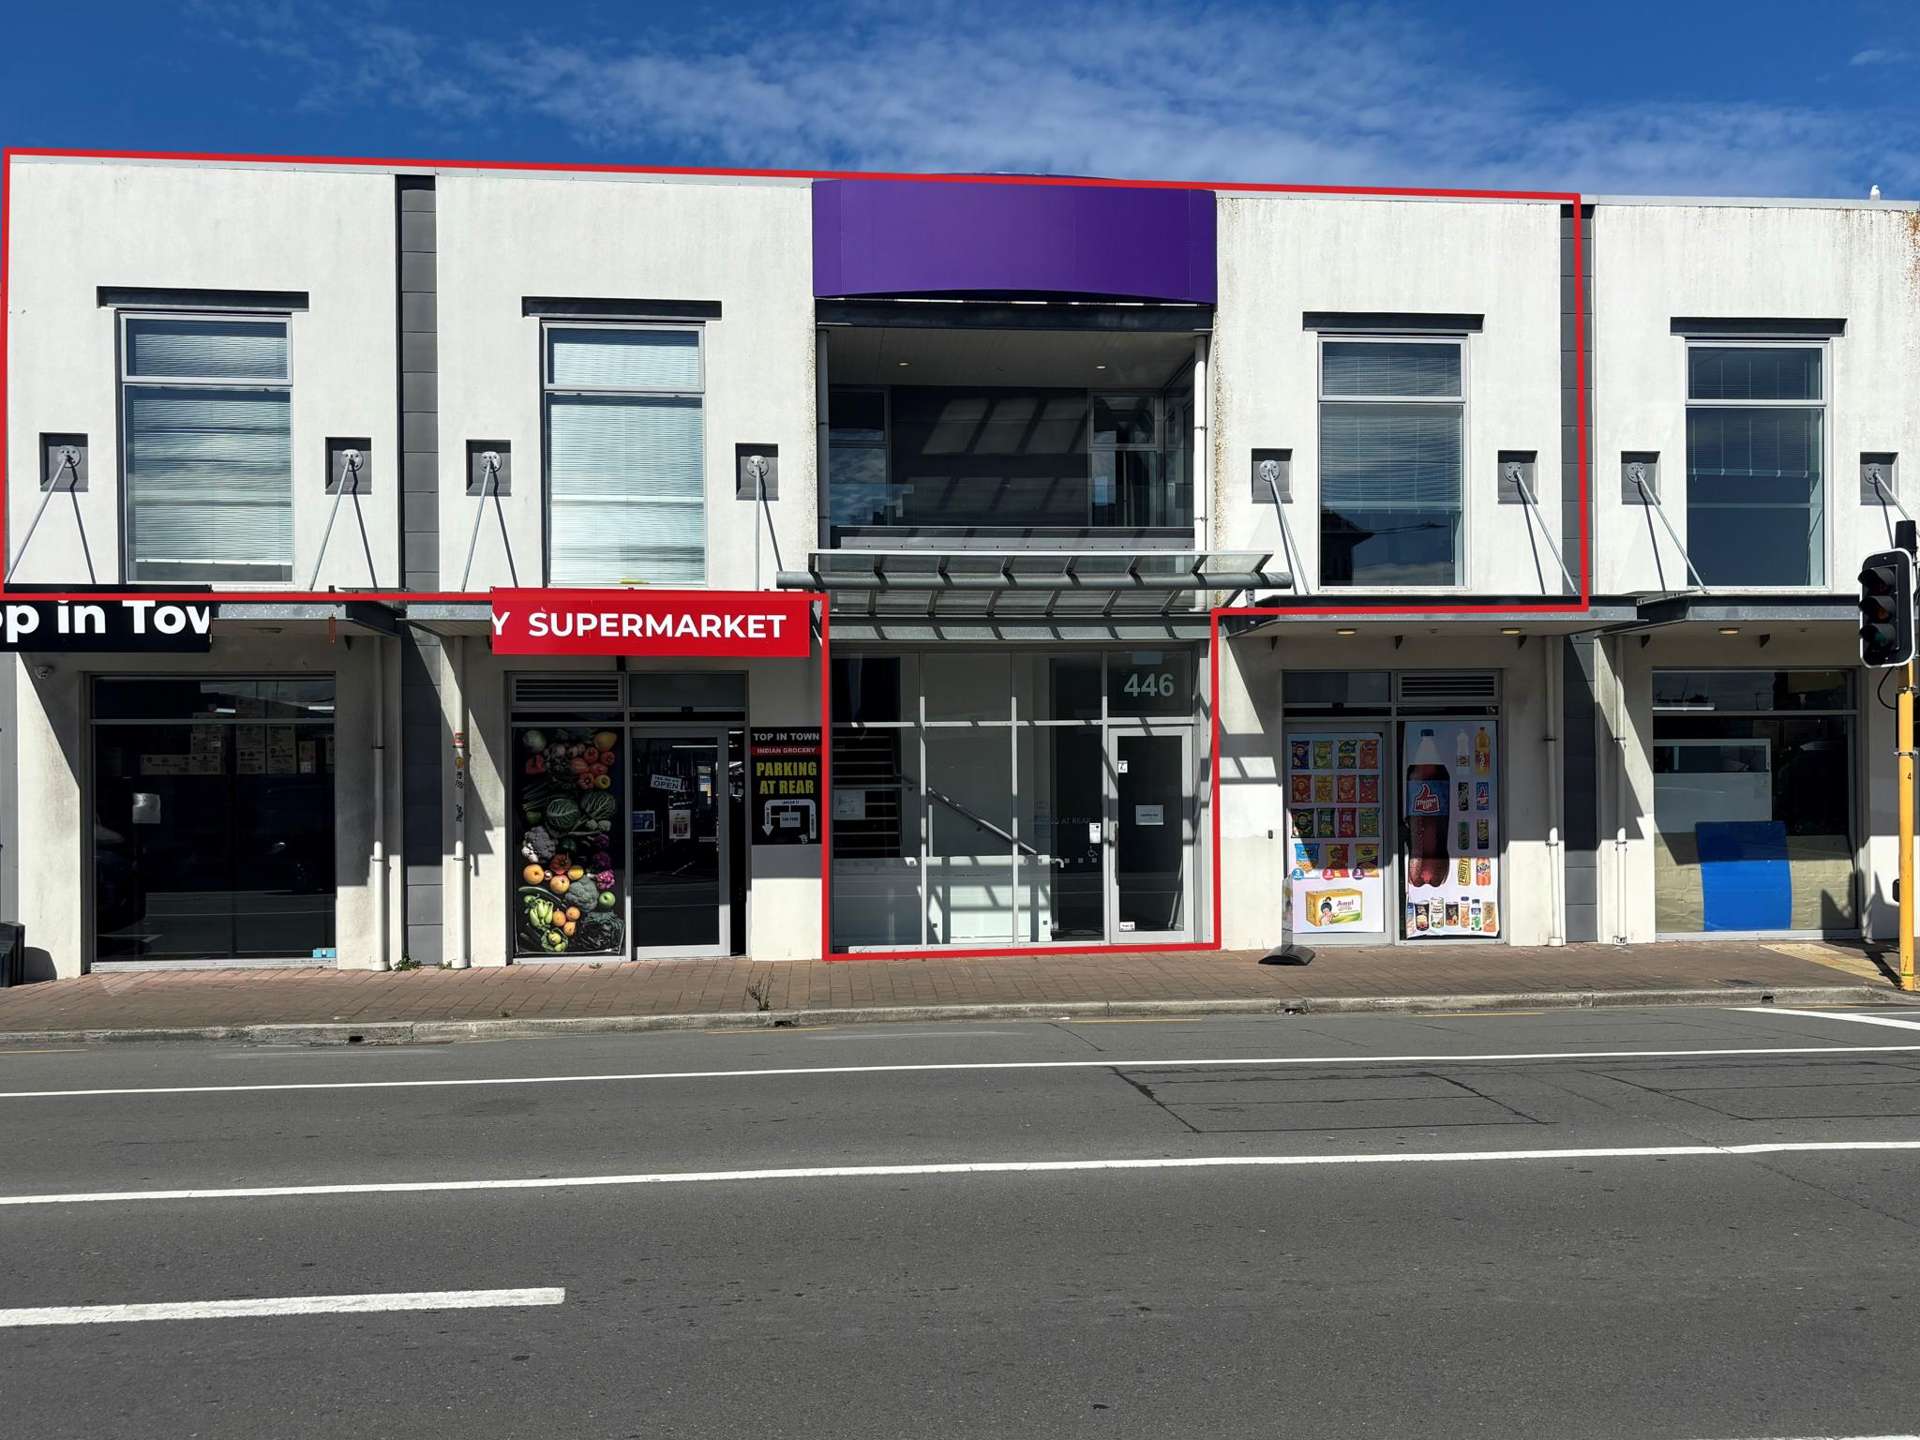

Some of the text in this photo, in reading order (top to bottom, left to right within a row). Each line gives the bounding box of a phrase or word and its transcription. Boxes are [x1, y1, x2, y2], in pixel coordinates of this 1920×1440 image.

[0, 604, 40, 643] p
[57, 599, 106, 634] in
[492, 611, 787, 638] Y SUPERMARKET
[1123, 673, 1175, 697] 446
[753, 732, 820, 741] TOP IN TOWN
[756, 761, 817, 776] PARKING
[654, 780, 680, 790] OPEN
[759, 780, 814, 794] AT REAR
